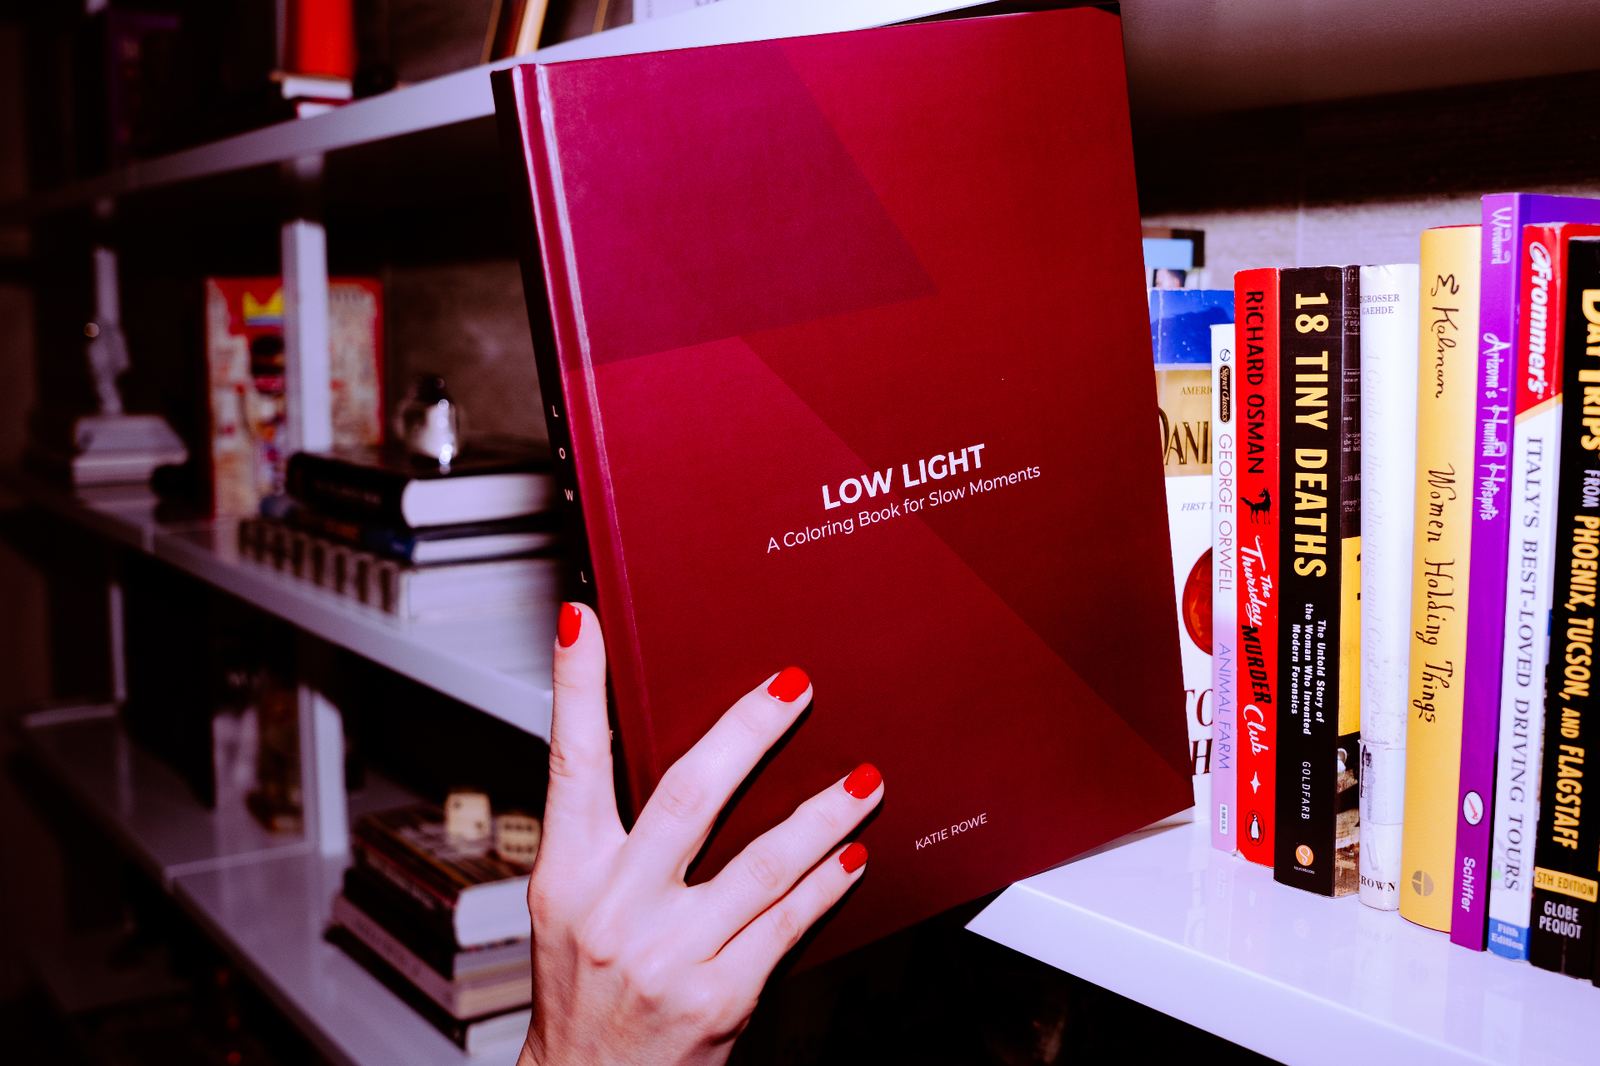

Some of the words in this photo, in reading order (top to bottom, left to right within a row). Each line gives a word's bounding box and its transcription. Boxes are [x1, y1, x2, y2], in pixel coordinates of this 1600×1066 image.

[1295, 292, 1329, 334] 18
[1527, 241, 1552, 396] Frommer's
[1431, 306, 1459, 399] Kalman
[1220, 391, 1230, 422] Classics
[1295, 350, 1329, 430] TINY
[1158, 407, 1212, 465] ANI
[1246, 394, 1265, 474] OSMAN
[1481, 404, 1509, 457] Haunted
[822, 467, 893, 510] LOW
[902, 443, 985, 488] LIGHT
[1218, 433, 1233, 513] GEORGE
[1475, 463, 1506, 520] Hotspots
[1523, 436, 1543, 528] ITALY'S
[1582, 469, 1600, 508] FROM
[766, 537, 780, 553] A
[783, 516, 854, 547] Coloring
[858, 503, 901, 527] Book
[903, 496, 926, 514] for
[929, 486, 966, 507] Slow
[970, 465, 1041, 496] Moments
[1181, 502, 1206, 511] FIRST
[1293, 448, 1328, 577] DEATHS
[1427, 462, 1456, 543] Women
[1218, 520, 1233, 593] ORWELL
[1240, 535, 1266, 628] Thursday
[1564, 515, 1600, 612] PHOENIX,
[1259, 574, 1273, 598] The
[1304, 603, 1314, 620] the
[1416, 558, 1455, 647] Holding
[1515, 540, 1538, 687] BEST-LOVED
[1292, 623, 1301, 662] Modern
[1304, 624, 1314, 661] Woman
[1317, 620, 1326, 639] The
[1218, 643, 1231, 715] ANIMAL
[1241, 624, 1272, 705] MURDER
[1303, 665, 1313, 688] Who
[1316, 641, 1326, 677] Untold
[1558, 617, 1594, 700] TUCSON,
[1291, 666, 1300, 715] Forensics
[1302, 690, 1313, 735] Invented
[1314, 679, 1326, 708] Story
[1315, 710, 1325, 723] of
[1412, 660, 1453, 724] Things
[1218, 722, 1231, 770] FARM
[1243, 704, 1269, 757] Club
[1508, 698, 1530, 803] DRIVING
[1560, 706, 1581, 739] AND
[1301, 760, 1311, 820] GOLDFARB
[1552, 743, 1585, 850] FLAGSTAFF
[915, 828, 948, 850] KATIE
[951, 812, 988, 836] ROWE
[1504, 814, 1524, 892] TOURS
[1361, 875, 1396, 892] ROWN
[1461, 856, 1476, 913] Schiffer
[1535, 870, 1555, 886] 5TH
[1557, 876, 1595, 896] EDITION
[1544, 900, 1579, 922] GLOBE
[1539, 915, 1582, 939] PEQUOT
